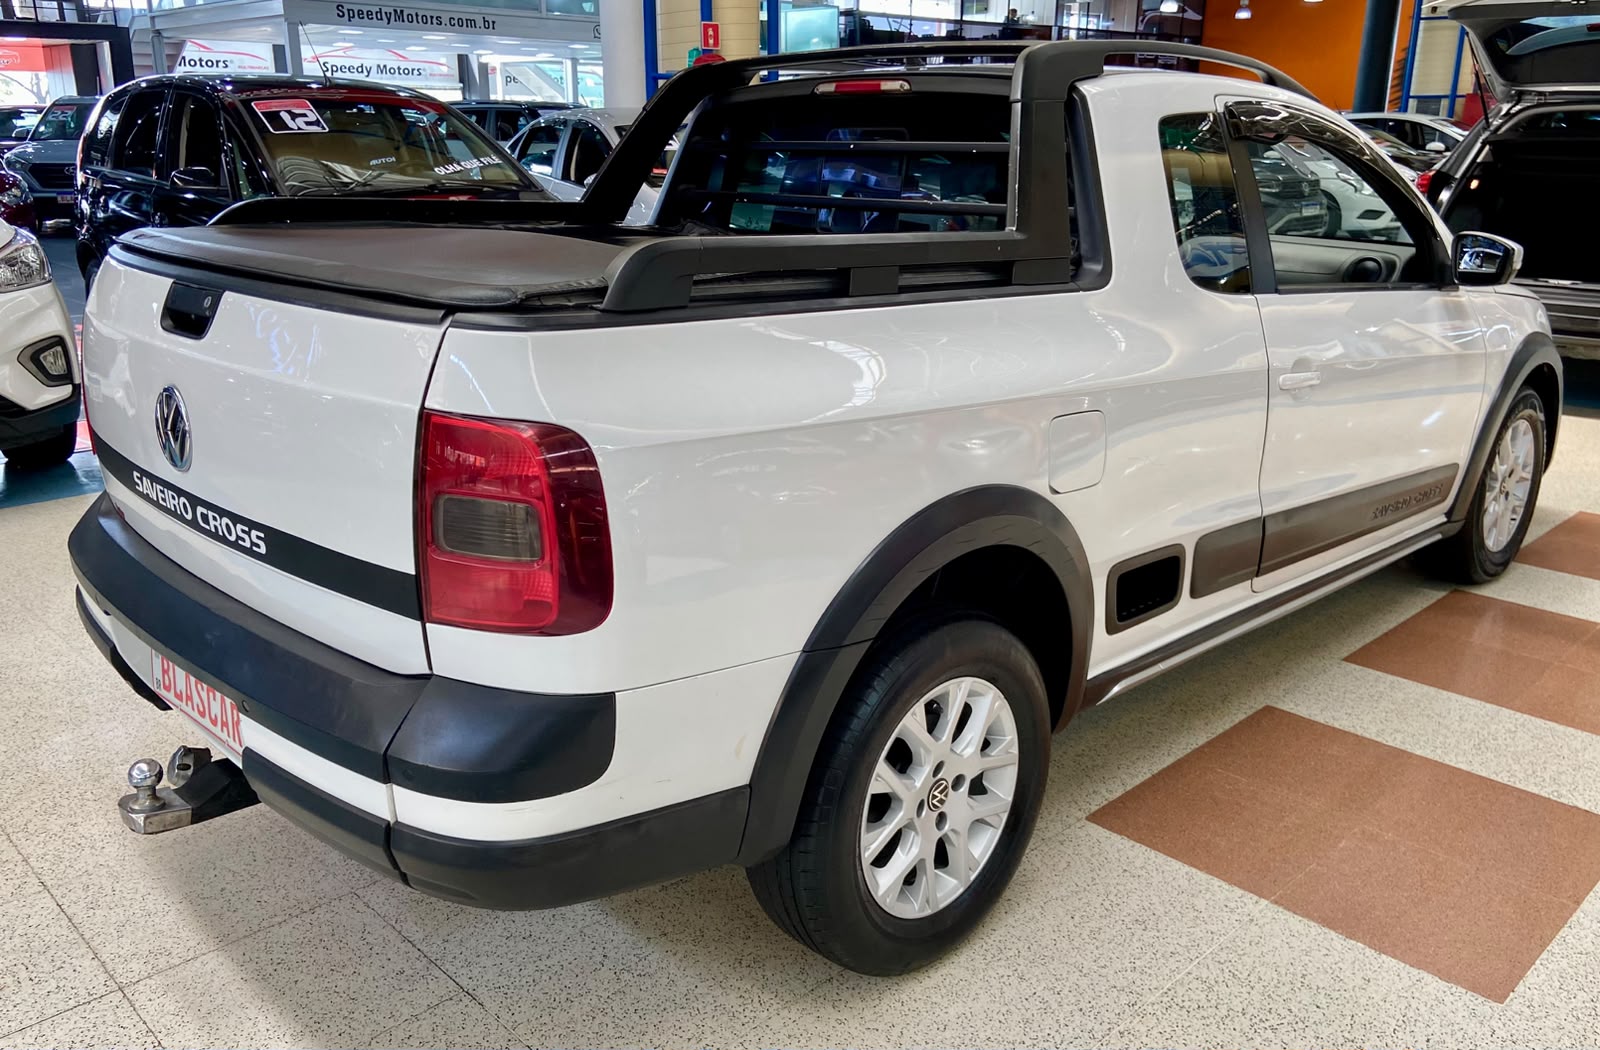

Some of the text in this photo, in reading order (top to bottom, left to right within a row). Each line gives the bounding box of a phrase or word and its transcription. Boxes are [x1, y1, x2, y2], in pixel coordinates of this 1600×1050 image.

[336, 4, 497, 31] SpeedyMotors.com.br
[322, 61, 423, 78] Speedy Motors
[279, 109, 323, 130] 12
[132, 470, 267, 555] SAVEIRO CROSS
[160, 655, 243, 749] BLASCAR
